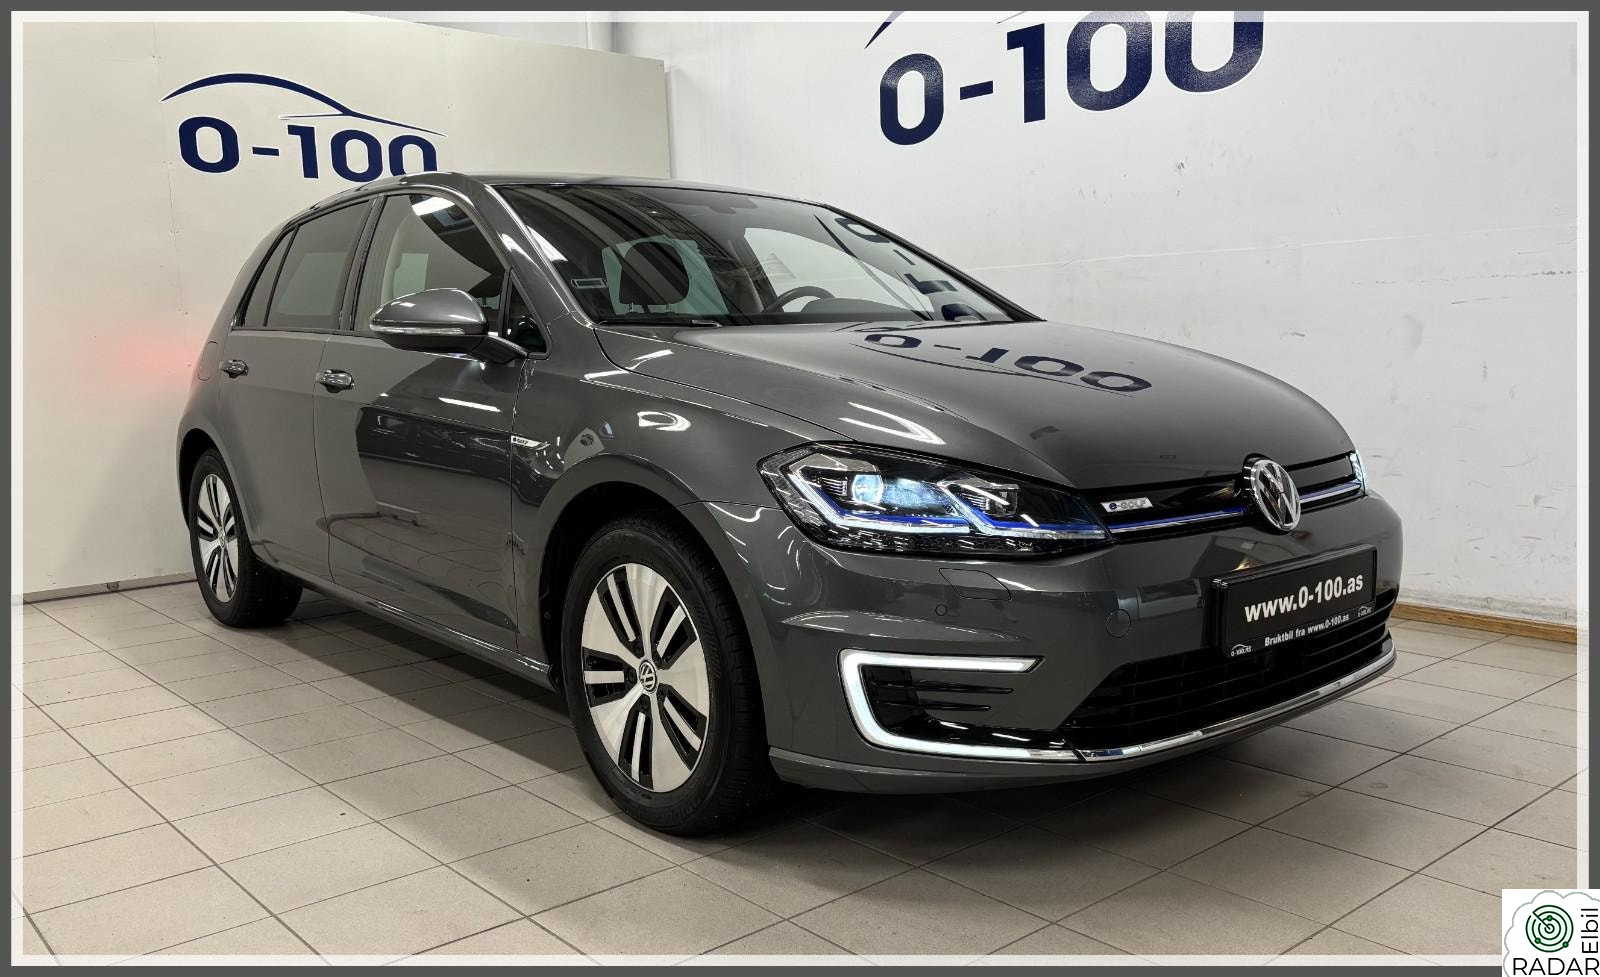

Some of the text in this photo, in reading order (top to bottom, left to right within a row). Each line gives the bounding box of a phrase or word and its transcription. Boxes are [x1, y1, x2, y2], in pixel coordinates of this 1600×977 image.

[880, 10, 1265, 146] 0-100
[178, 116, 438, 183] 0-100
[1244, 574, 1364, 623] www.0-100.as
[1264, 613, 1350, 647] Bruktbil fra www.0-100.as
